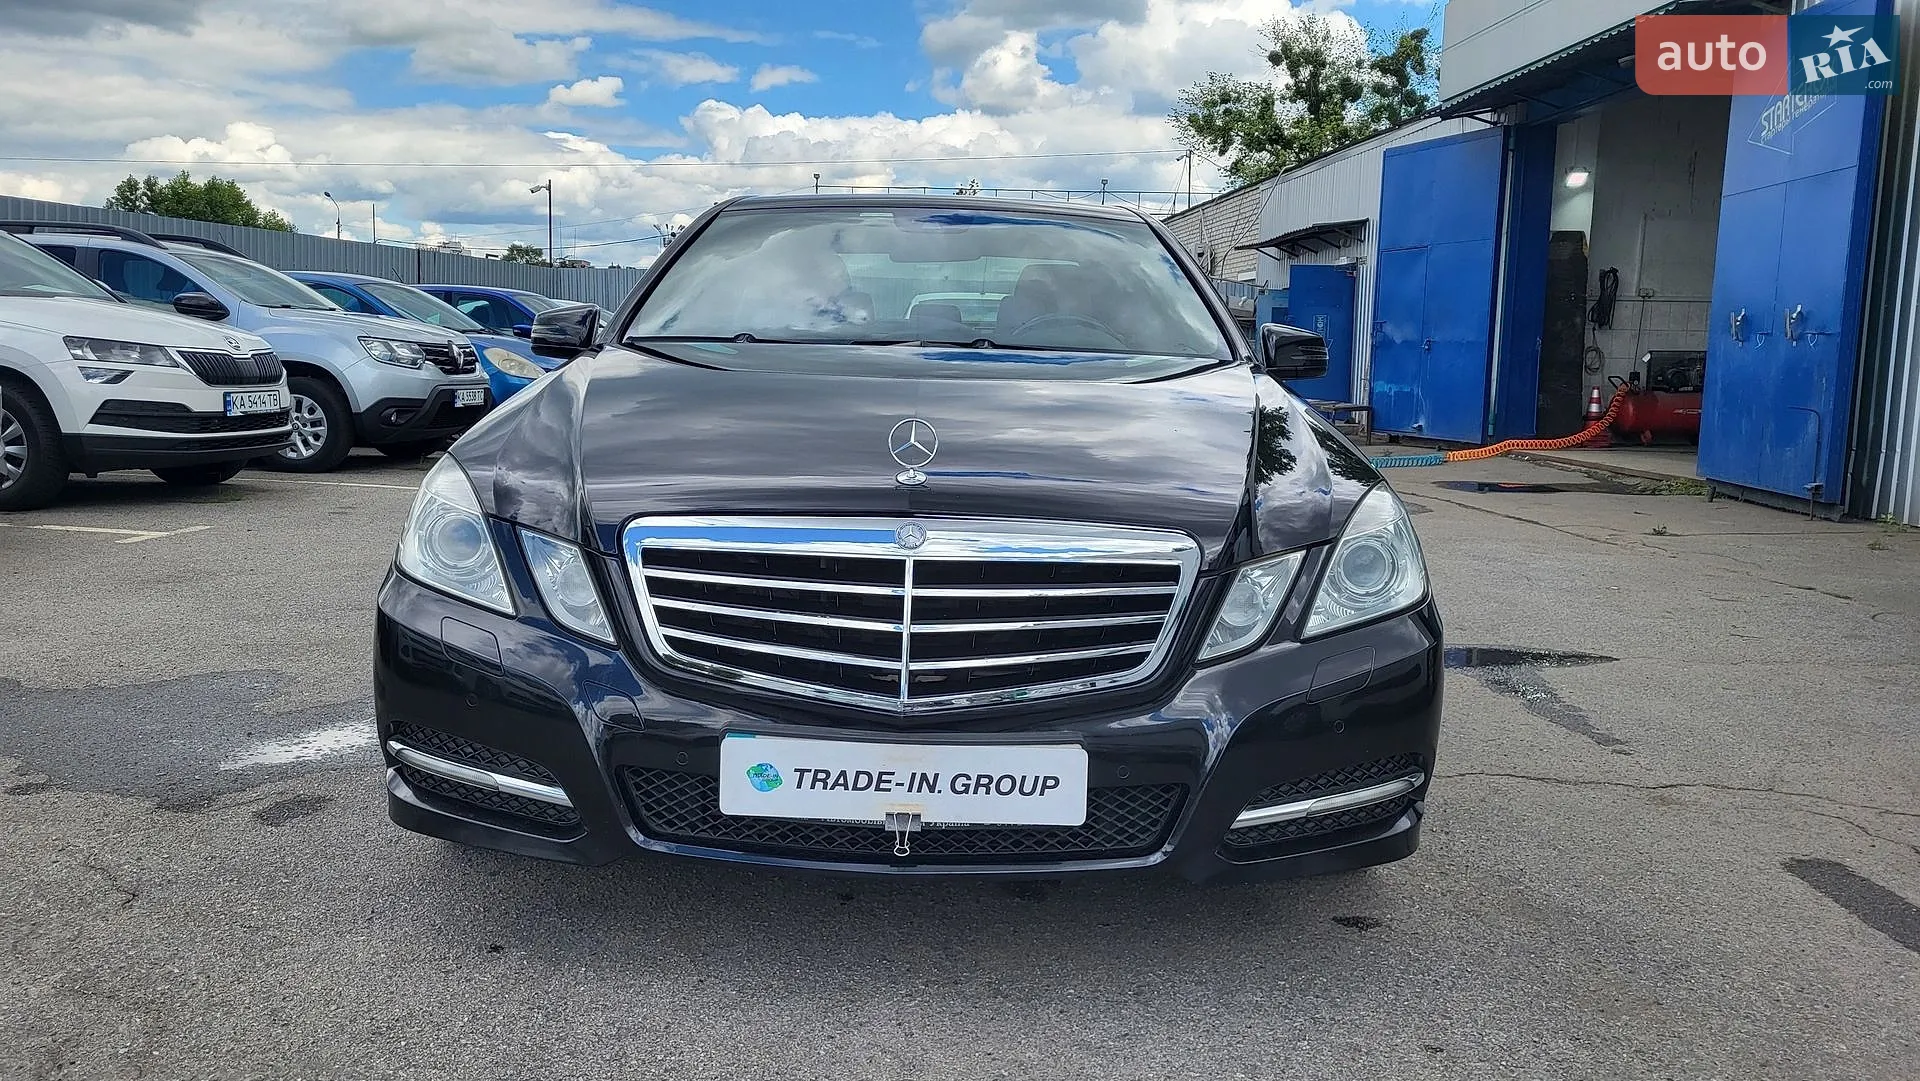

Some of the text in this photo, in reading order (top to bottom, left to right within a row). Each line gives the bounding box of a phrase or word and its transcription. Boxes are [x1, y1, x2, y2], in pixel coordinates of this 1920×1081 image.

[231, 393, 278, 410] KA 5414 TB
[949, 773, 1061, 797] GROUP
